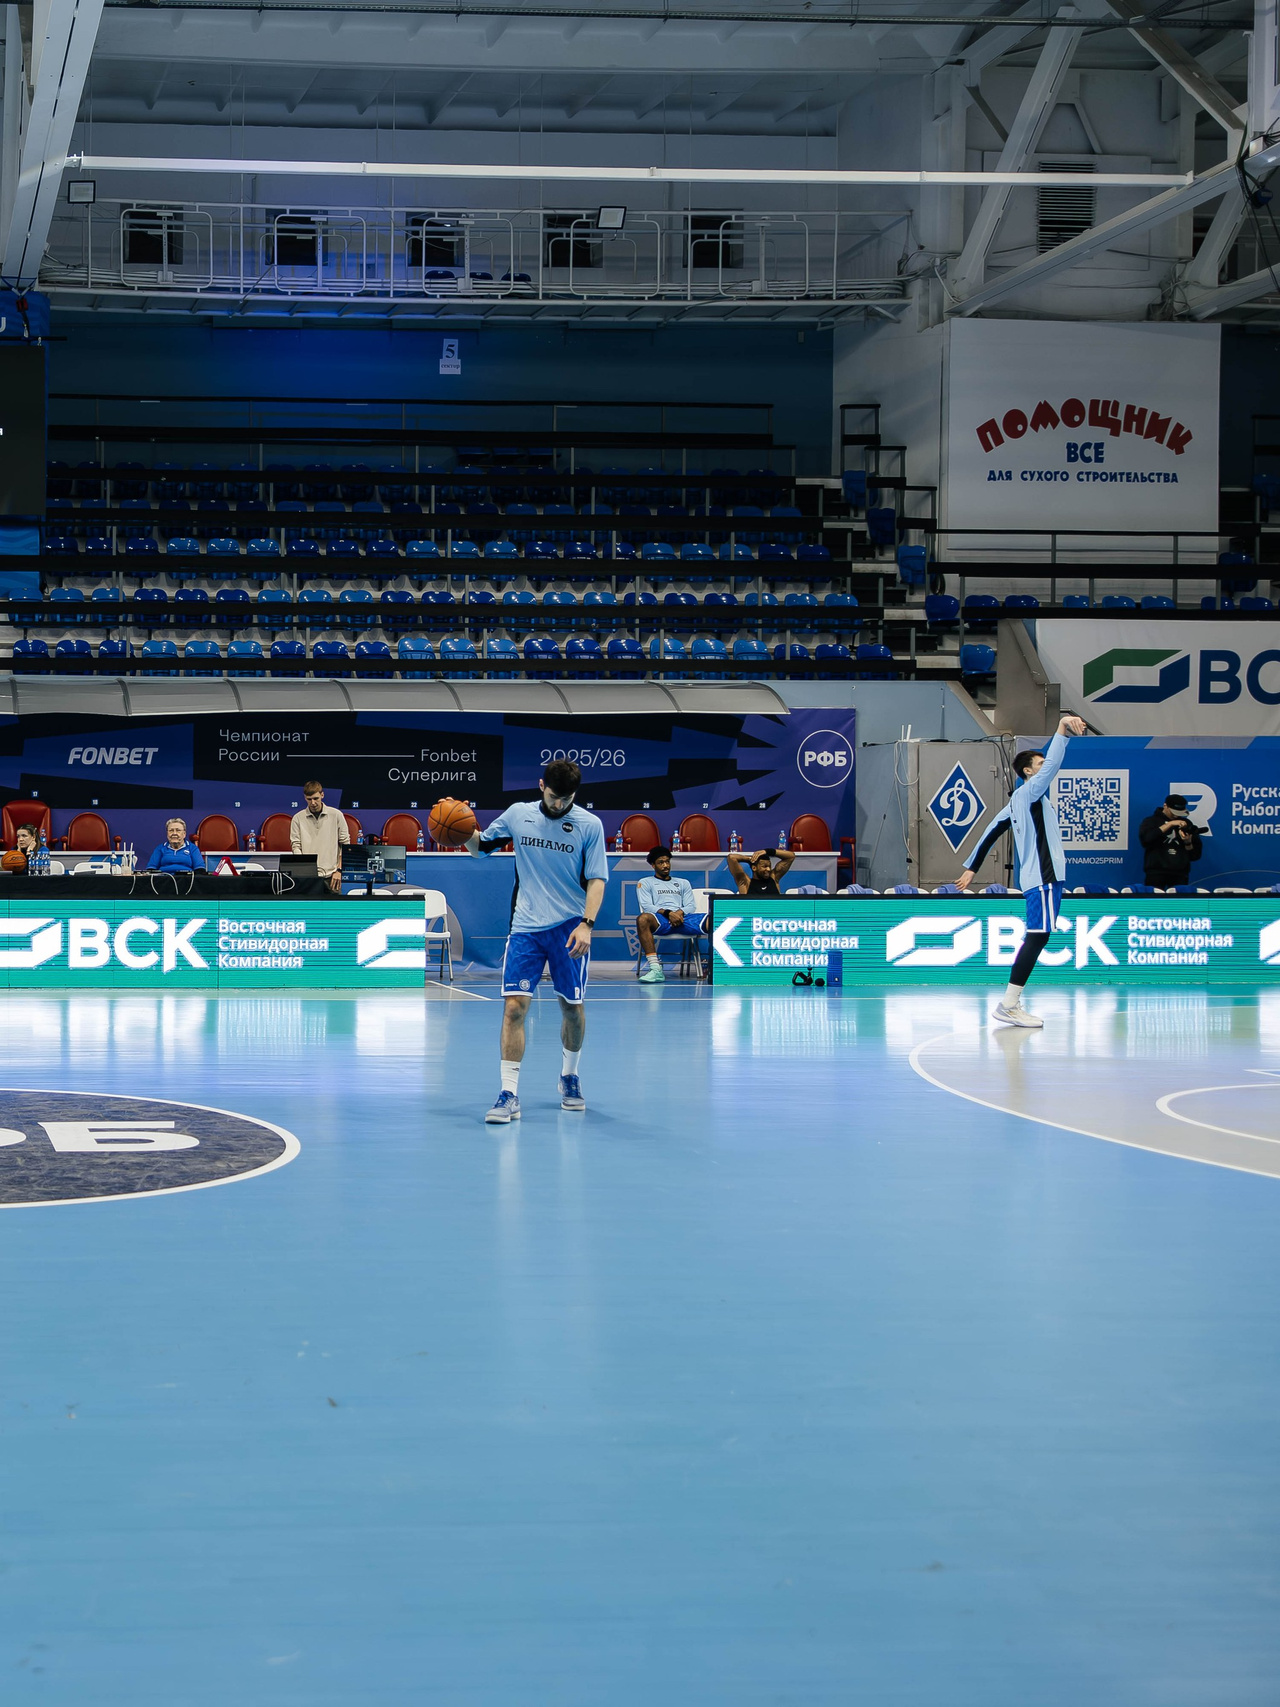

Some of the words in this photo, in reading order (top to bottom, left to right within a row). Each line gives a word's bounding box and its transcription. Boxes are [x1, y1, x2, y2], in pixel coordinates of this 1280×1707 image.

[446, 344, 455, 359] 5
[975, 397, 1193, 456] ПОМОЩНИК
[1066, 441, 1105, 464] ВСЕ
[987, 469, 1013, 482] ДЛЯ
[1020, 470, 1070, 482] СУХОГО
[1076, 470, 1179, 483] СТРОИТЕЛЬСТВА
[219, 728, 310, 744] Чемпионат
[67, 746, 159, 765] FONBET
[218, 748, 280, 762] России
[421, 748, 478, 763] Fonbet
[540, 747, 626, 768] 2025/26
[804, 751, 847, 767] РФБ
[388, 767, 478, 785] Суперлига
[1231, 820, 1280, 835] Компа
[520, 836, 575, 854] ДИНАМО
[218, 919, 306, 934] Восточная
[751, 917, 838, 932] Восточная
[1127, 916, 1212, 931] Восточная
[68, 917, 209, 973] ВСК
[218, 936, 329, 953] Стивидорная
[751, 935, 860, 951] Стивидорная
[1126, 932, 1234, 949] Стивидорная
[218, 954, 304, 969] Компания
[1127, 950, 1209, 965] Компания
